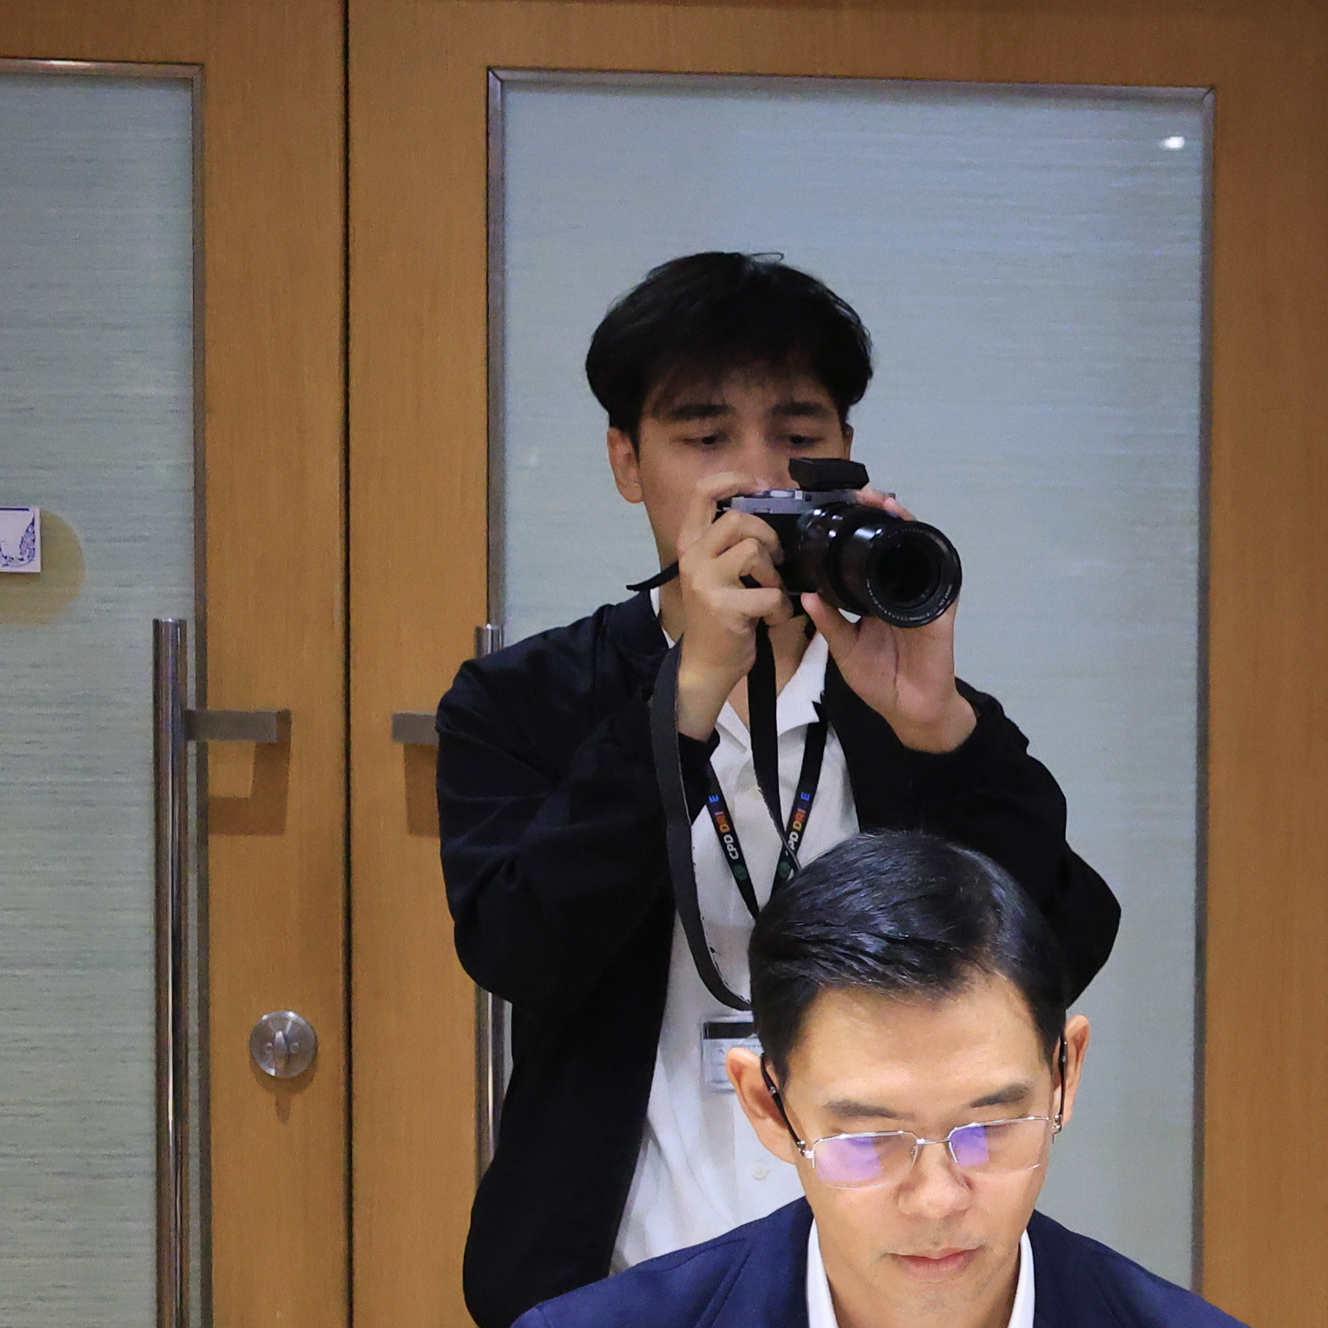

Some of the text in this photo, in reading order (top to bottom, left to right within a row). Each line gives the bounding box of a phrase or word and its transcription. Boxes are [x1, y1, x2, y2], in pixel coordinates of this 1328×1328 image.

[708, 795, 739, 860] CPD DRIE
[793, 792, 811, 831] DRIE
